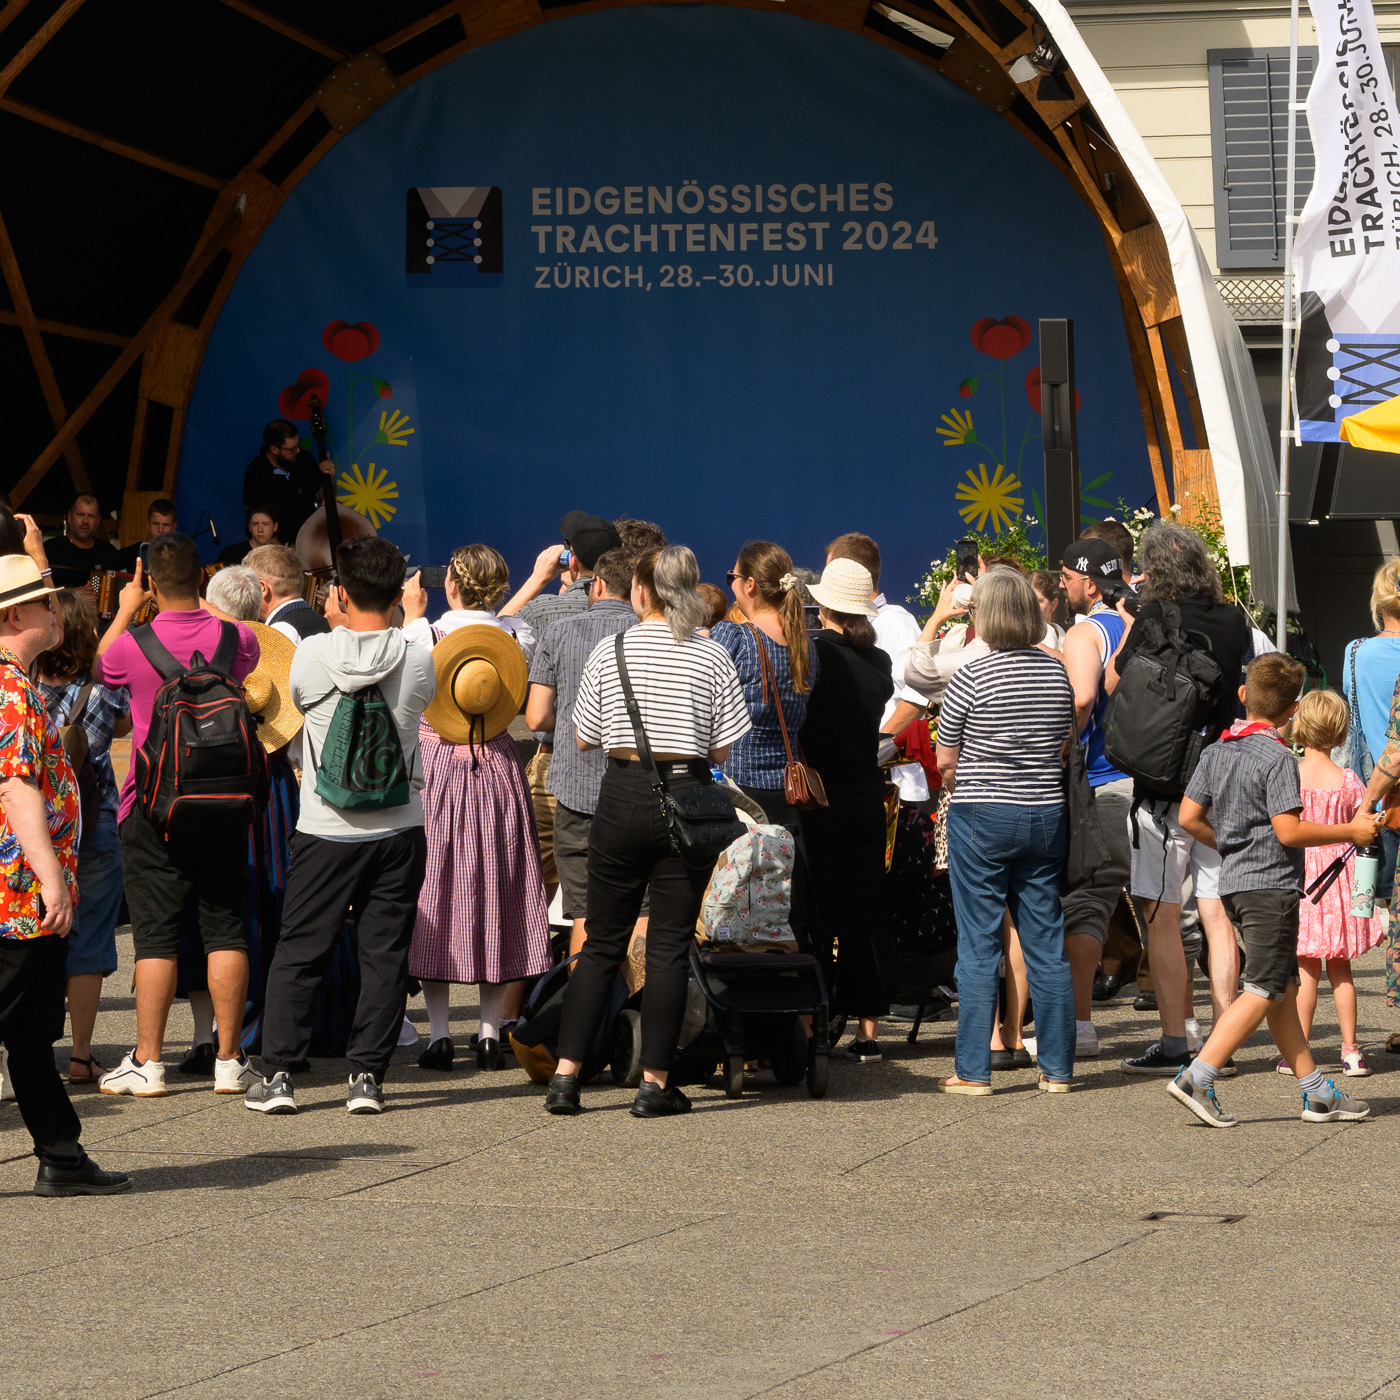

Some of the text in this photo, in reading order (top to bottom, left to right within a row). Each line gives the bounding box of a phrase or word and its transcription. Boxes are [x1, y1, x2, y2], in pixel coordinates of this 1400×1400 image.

[531, 180, 895, 217] EIDGENÖSSISCHES
[530, 219, 939, 254] TRACHTENFEST 2024
[534, 262, 653, 292] ZÜRICH,
